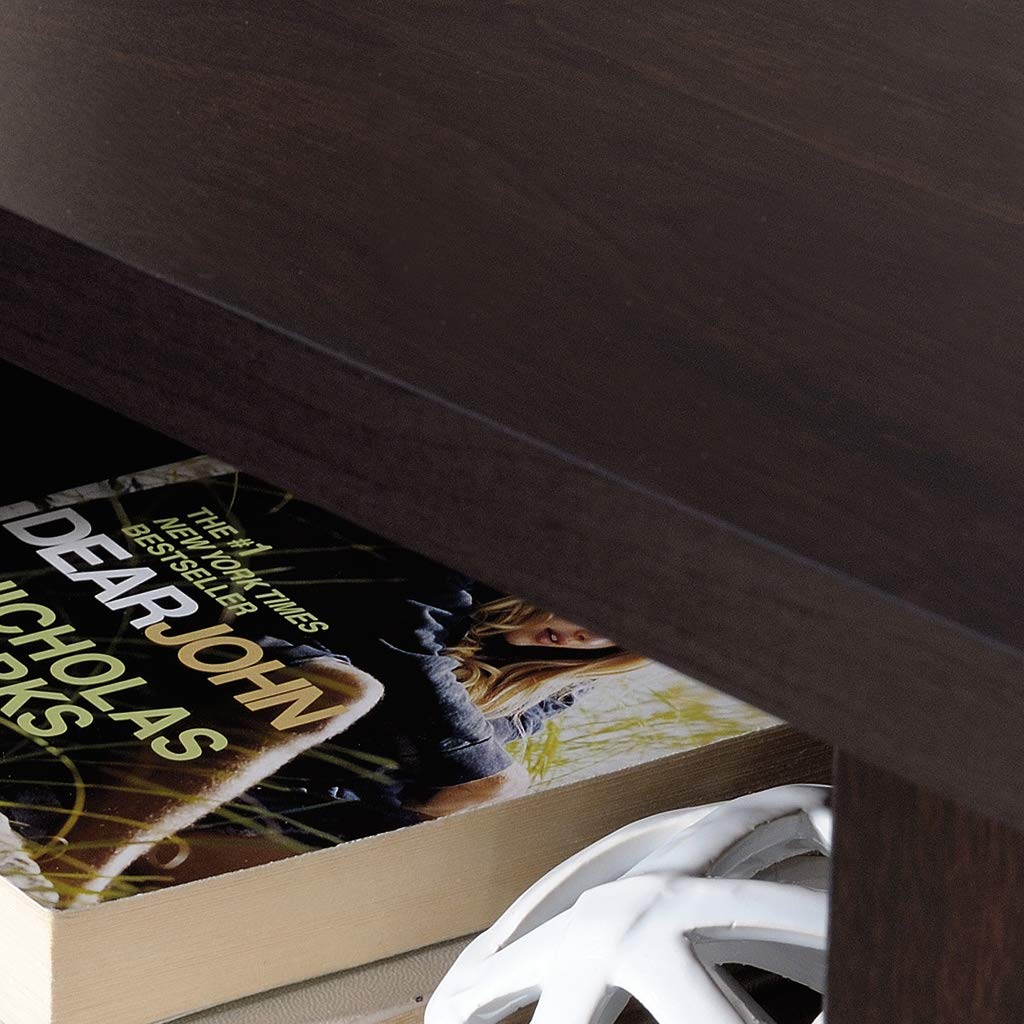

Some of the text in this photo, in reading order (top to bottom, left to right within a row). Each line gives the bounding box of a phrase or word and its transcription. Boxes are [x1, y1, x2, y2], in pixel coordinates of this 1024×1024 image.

[121, 523, 258, 616] BESTSELLER
[153, 517, 329, 633] NEW YORK TIMES
[187, 506, 273, 557] THE #1
[2, 507, 349, 731] DEAR JOHN
